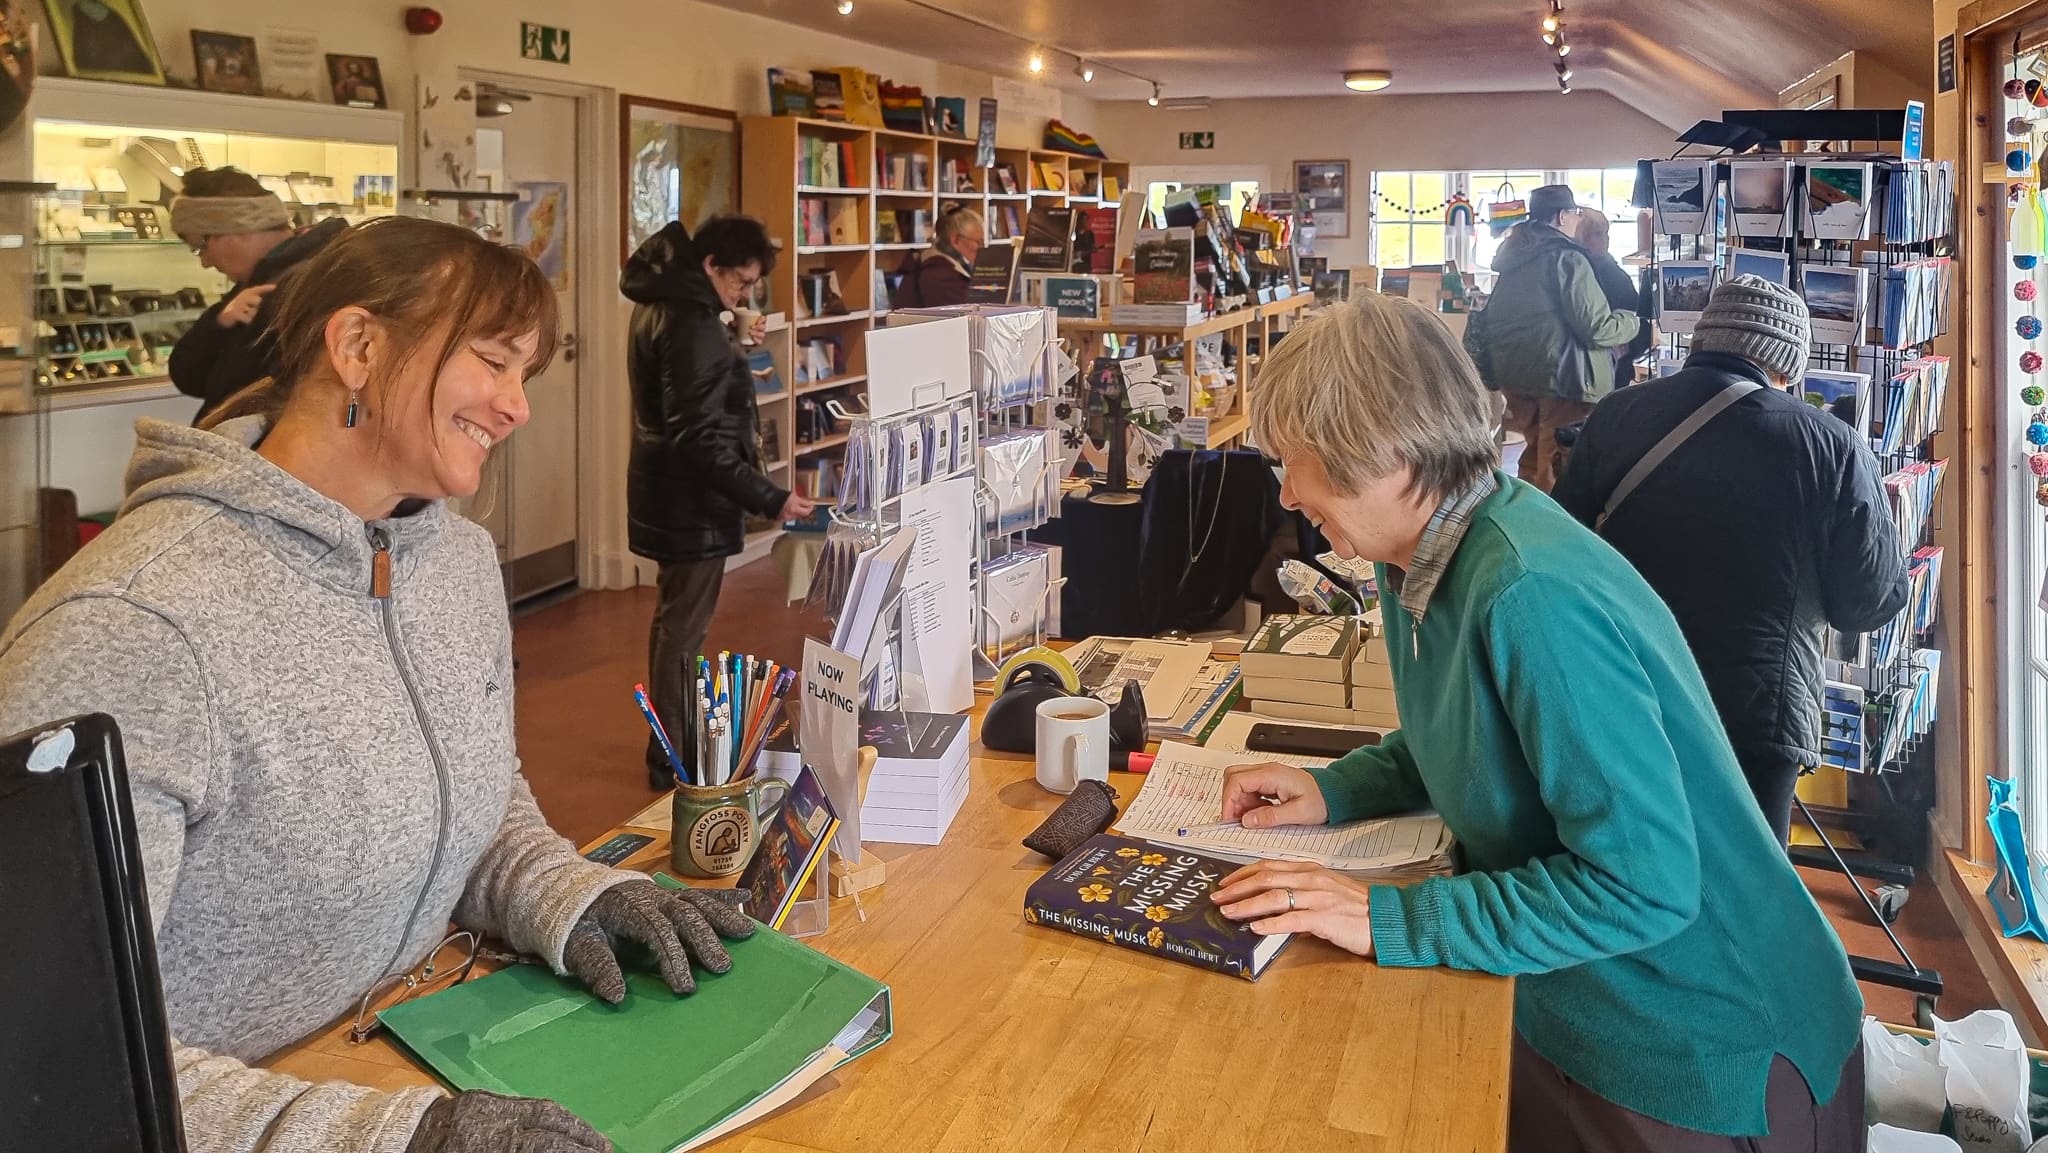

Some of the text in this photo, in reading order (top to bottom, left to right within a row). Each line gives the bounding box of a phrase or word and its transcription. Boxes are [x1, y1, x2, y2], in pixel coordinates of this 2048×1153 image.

[1058, 298, 1087, 306] BOOKS
[1061, 289, 1082, 297] NEW
[817, 660, 844, 684] NOW
[808, 680, 853, 713] PLAYING
[695, 809, 750, 850] FANGFOSS POTTERY
[1119, 865, 1155, 887] THE
[1123, 855, 1199, 914] MISSING
[1162, 870, 1219, 911] MUSK
[1039, 908, 1147, 946] THE MISSING MUSK
[1166, 942, 1219, 964] BOB GILBERT
